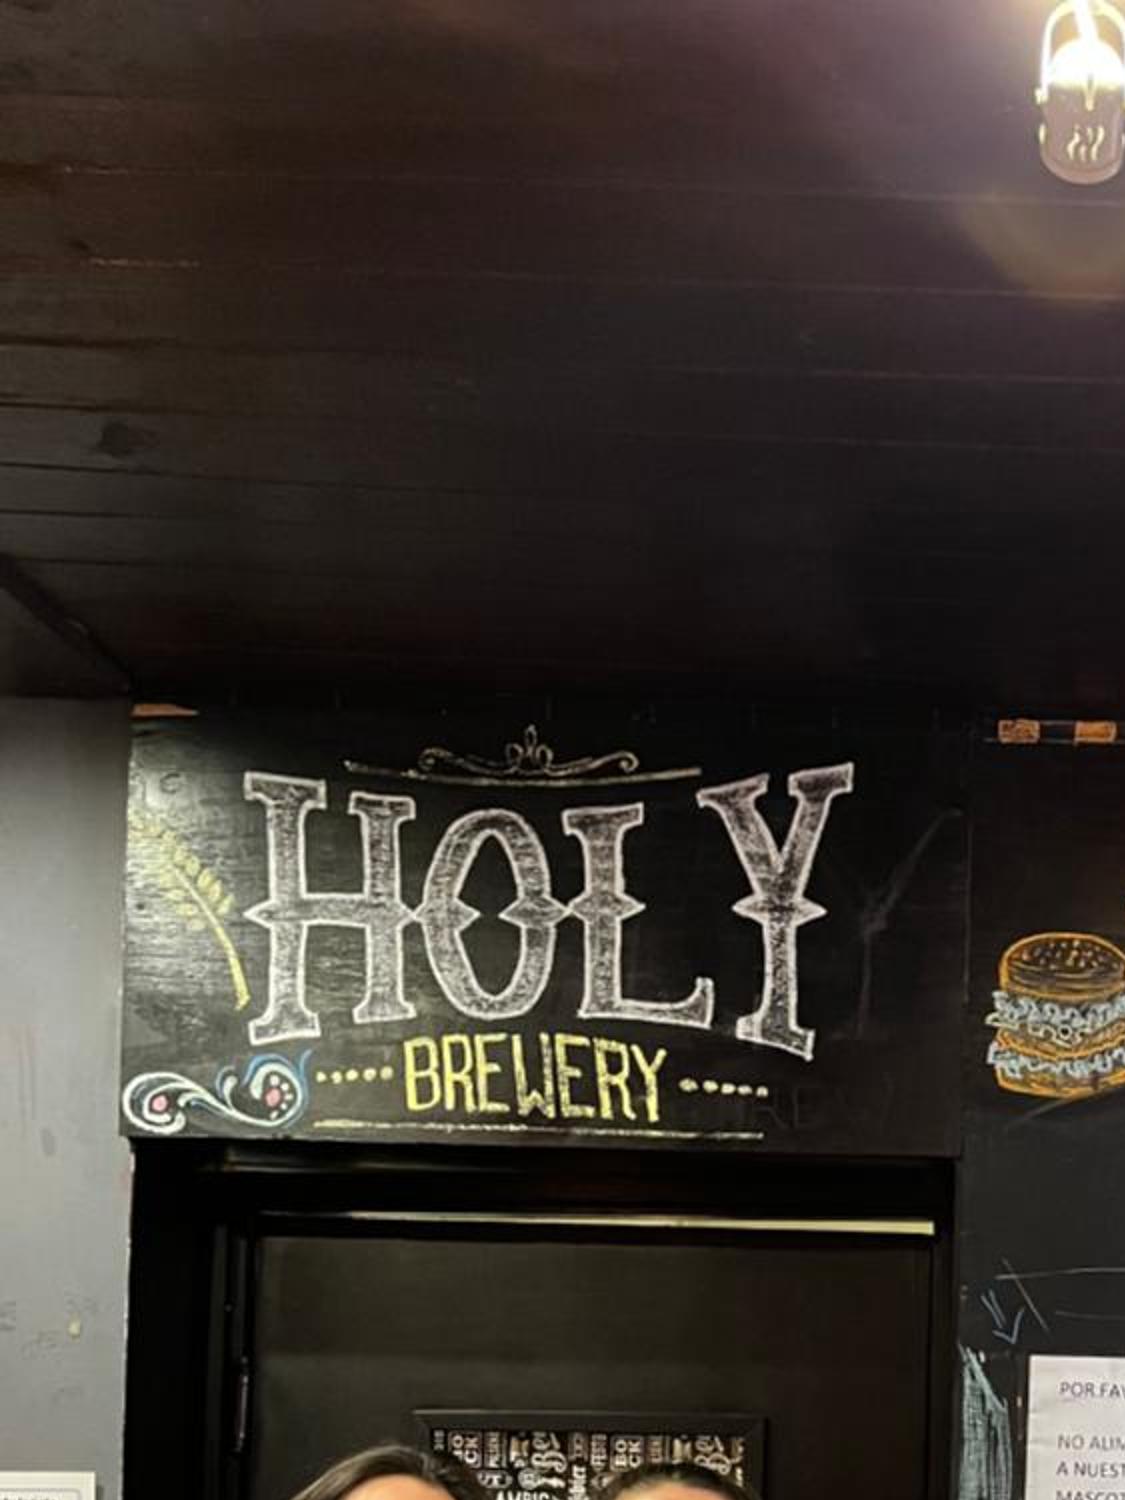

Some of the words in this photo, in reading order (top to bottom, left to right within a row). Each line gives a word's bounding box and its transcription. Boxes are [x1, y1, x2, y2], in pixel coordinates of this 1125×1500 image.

[242, 761, 854, 1062] HOLY
[403, 1033, 667, 1122] BREWERY
[1059, 1381, 1096, 1398] POR
[1057, 1434, 1085, 1450] NO
[1056, 1462, 1069, 1477] A
